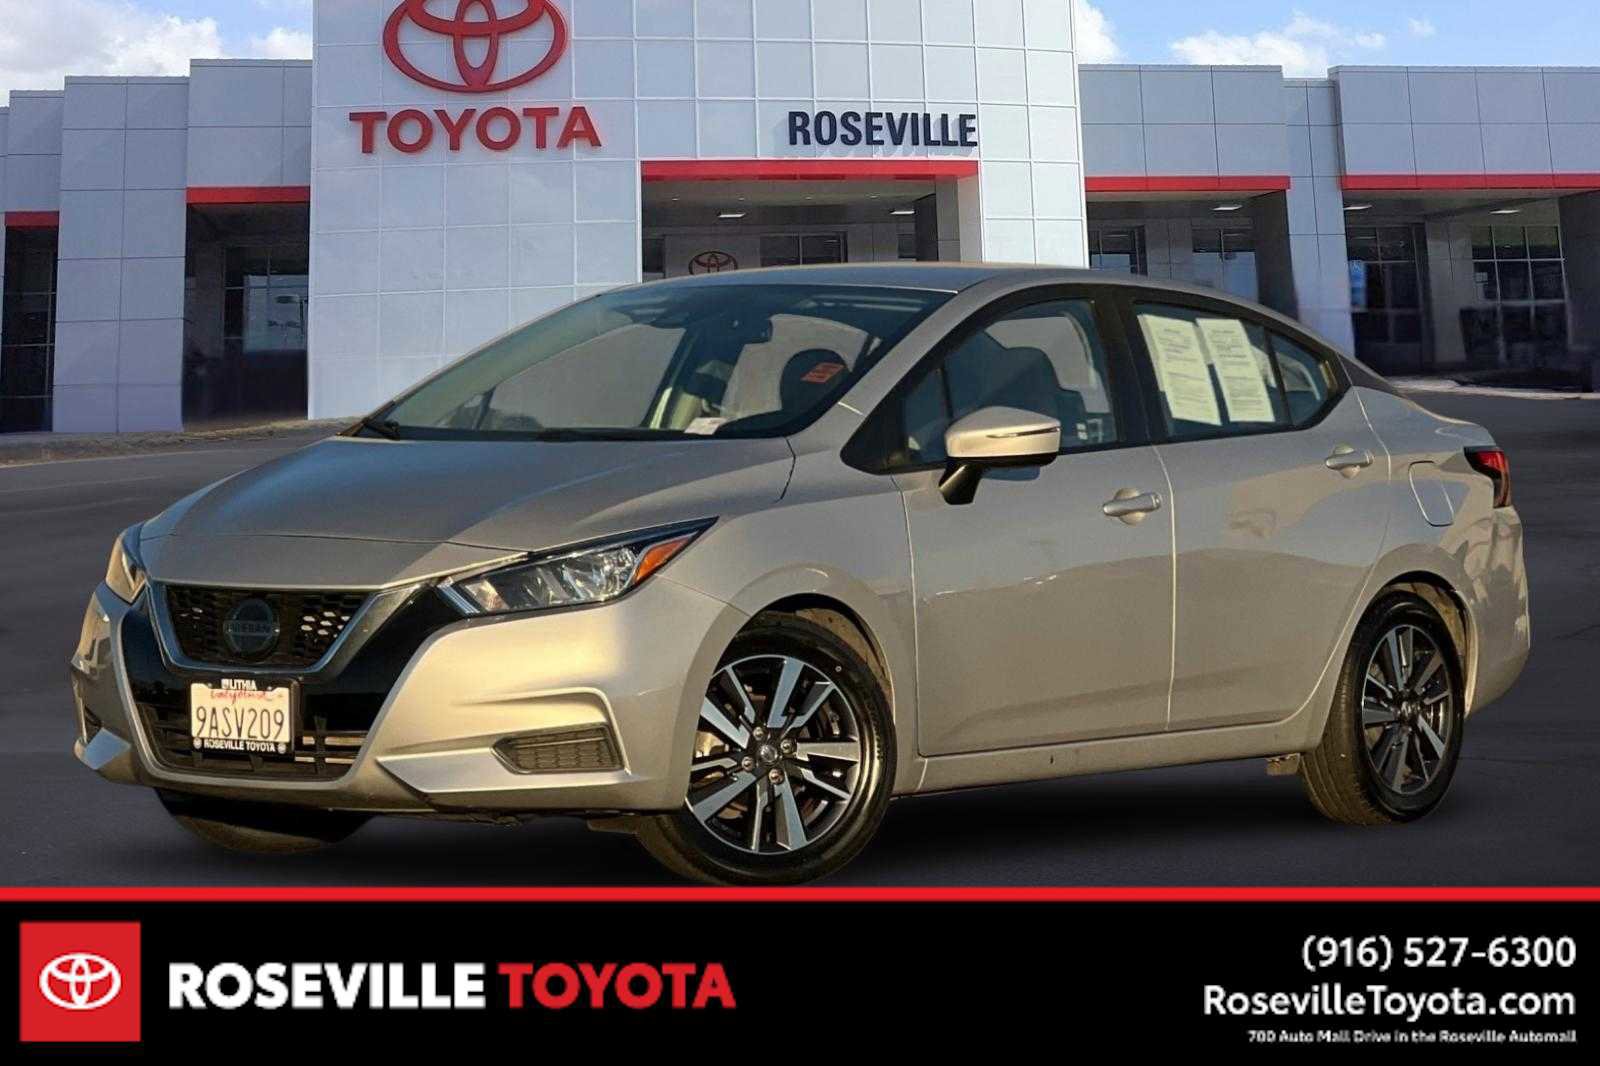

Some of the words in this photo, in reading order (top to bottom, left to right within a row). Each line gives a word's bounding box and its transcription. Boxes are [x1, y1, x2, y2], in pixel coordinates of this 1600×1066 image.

[349, 106, 602, 154] TOYOTA
[788, 111, 979, 147] ROSEVILLE
[229, 678, 257, 690] LITHIA
[196, 705, 285, 740] 9ASV209
[203, 739, 245, 751] ROSEVILLE
[246, 741, 276, 753] TOYOTA
